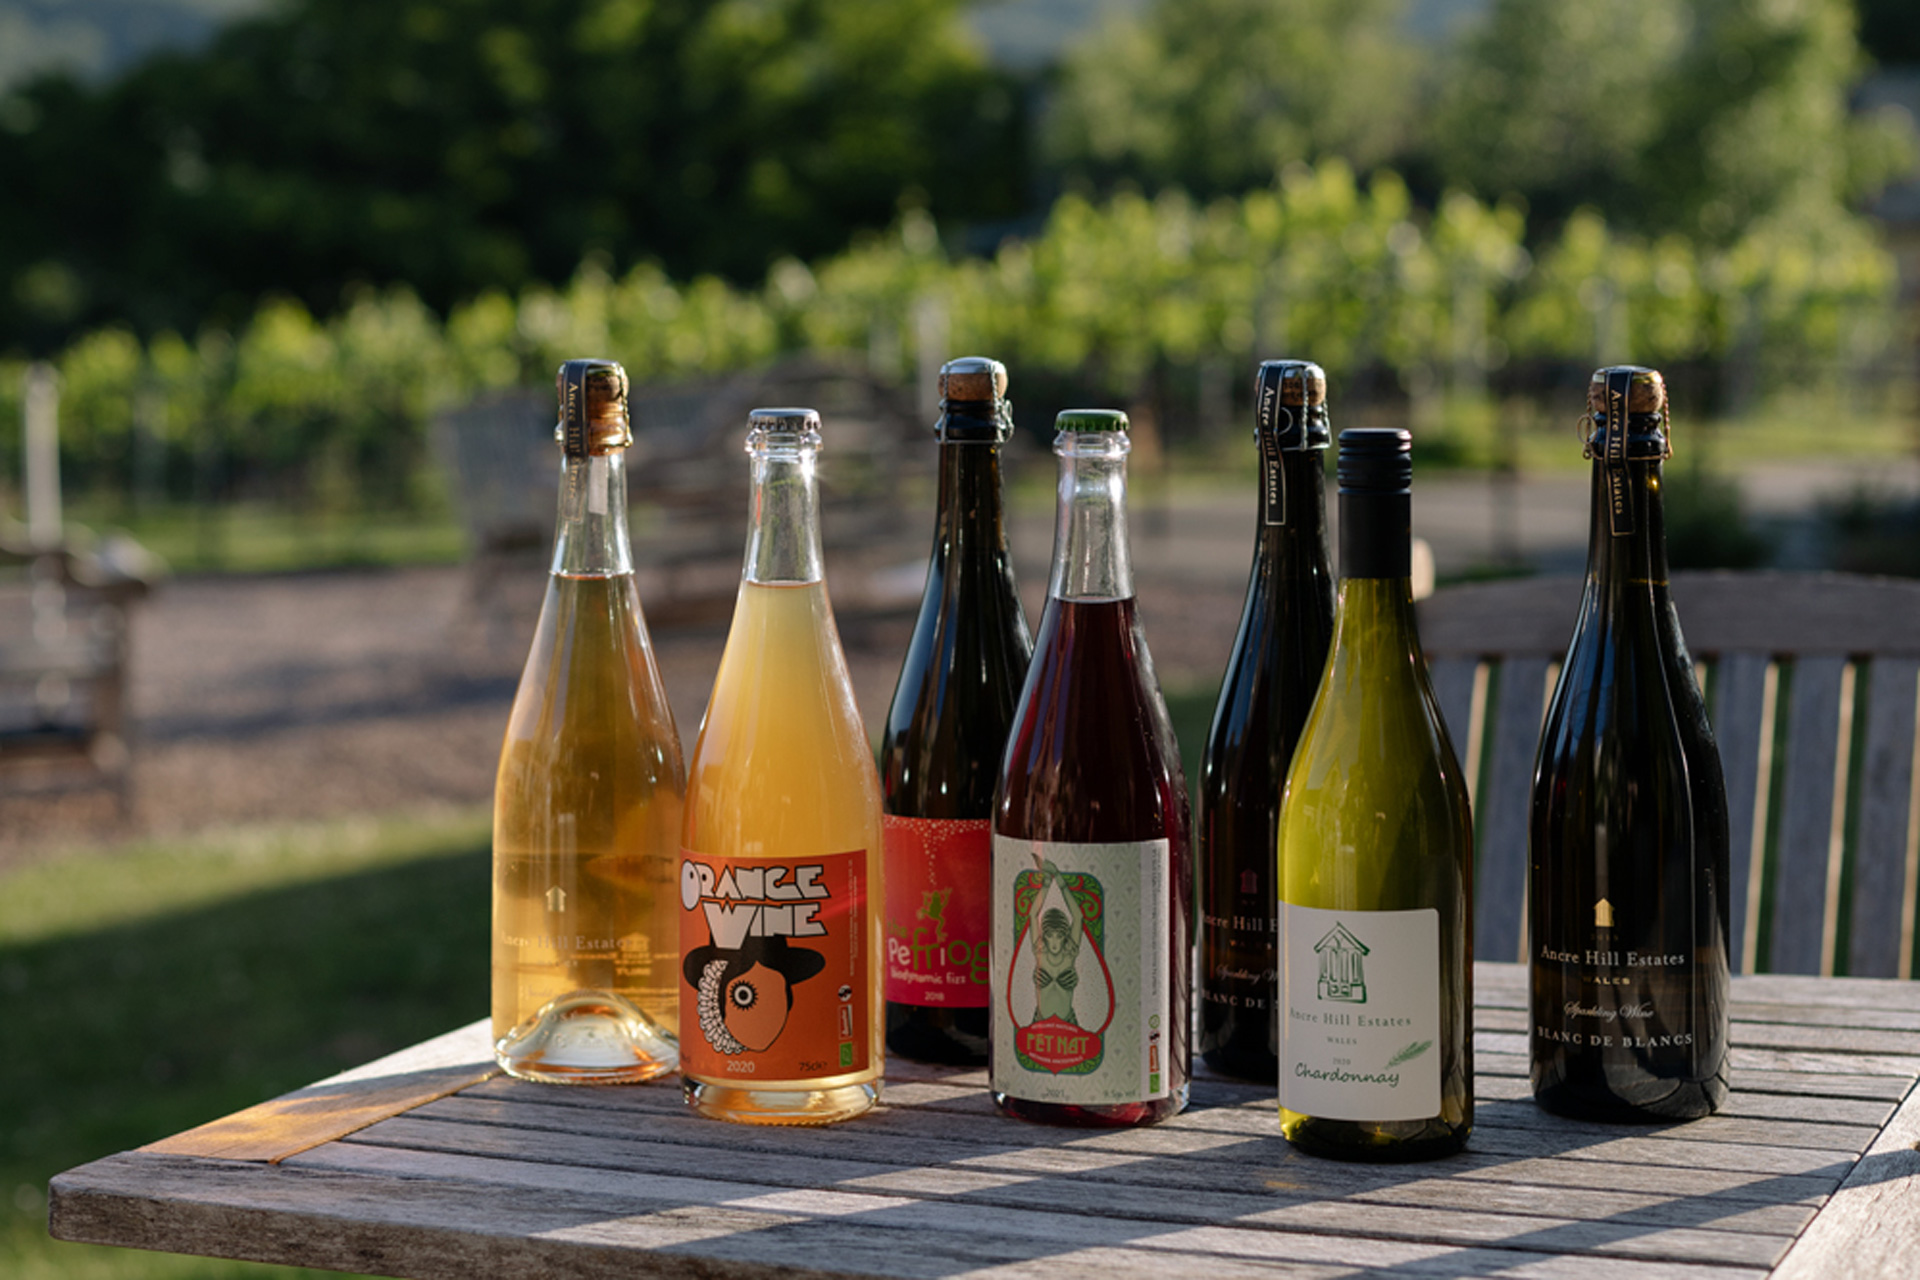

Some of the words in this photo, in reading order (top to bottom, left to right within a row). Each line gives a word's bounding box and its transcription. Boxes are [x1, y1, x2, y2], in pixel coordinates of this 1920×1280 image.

[568, 382, 579, 421] Ancre
[1610, 389, 1622, 431] Ancre
[1261, 387, 1275, 426] Ancre
[1269, 460, 1279, 505] Estates
[1613, 468, 1624, 515] Estates
[681, 859, 831, 911] ORANGE
[702, 900, 828, 950] WINE
[1233, 915, 1263, 932] Hill
[537, 935, 568, 950] Hill
[1540, 944, 1580, 964] Ancre
[1585, 950, 1620, 966] Hill
[1627, 952, 1685, 967] Estates
[1245, 997, 1267, 1009] DE
[1619, 1002, 1654, 1019] Wine
[1289, 1007, 1318, 1023] Ancre
[1323, 1012, 1350, 1026] Hill
[1357, 1015, 1411, 1027] Estates
[1056, 1035, 1090, 1055] NAT
[1326, 1036, 1358, 1045] WALES
[1537, 1025, 1582, 1044] BLANC
[1590, 1035, 1613, 1047] DE
[1622, 1033, 1693, 1048] BLANCS
[727, 1060, 756, 1073] 2020
[1295, 1062, 1400, 1088] Chardonnay
